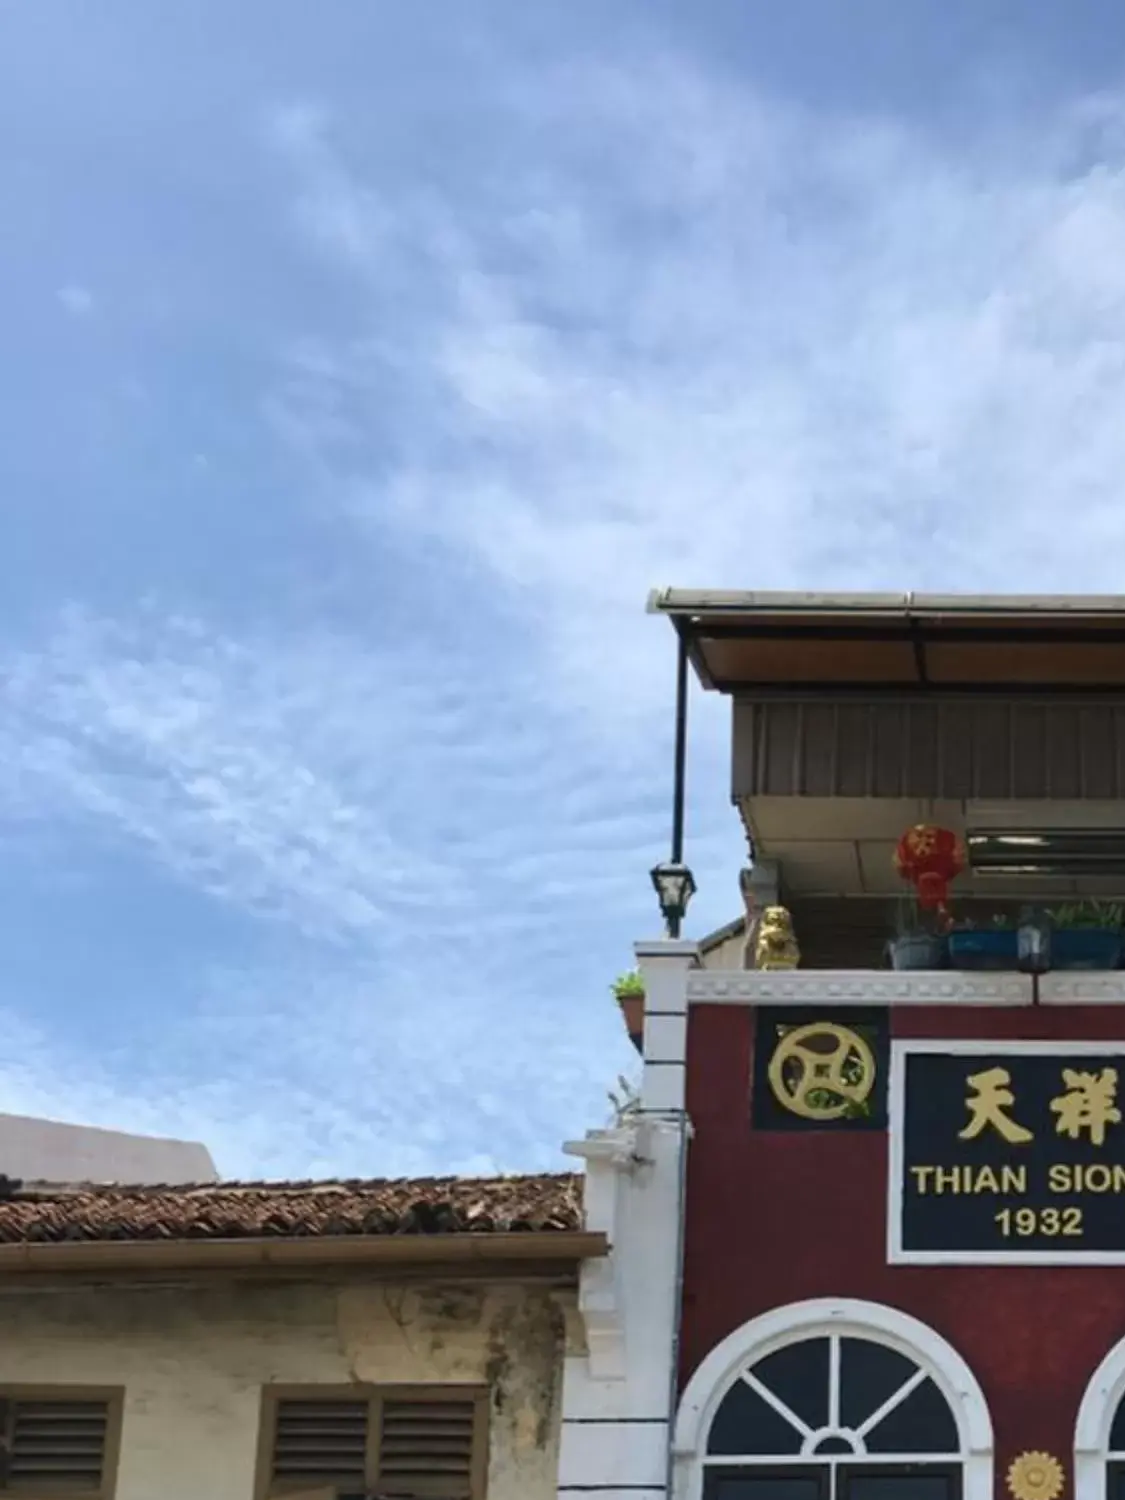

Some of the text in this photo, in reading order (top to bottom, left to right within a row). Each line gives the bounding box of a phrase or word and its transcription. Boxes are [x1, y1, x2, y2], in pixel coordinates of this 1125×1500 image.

[956, 1066, 1123, 1145] 天祥
[911, 1165, 1026, 1193] THIAN
[995, 1208, 1084, 1236] 1932
